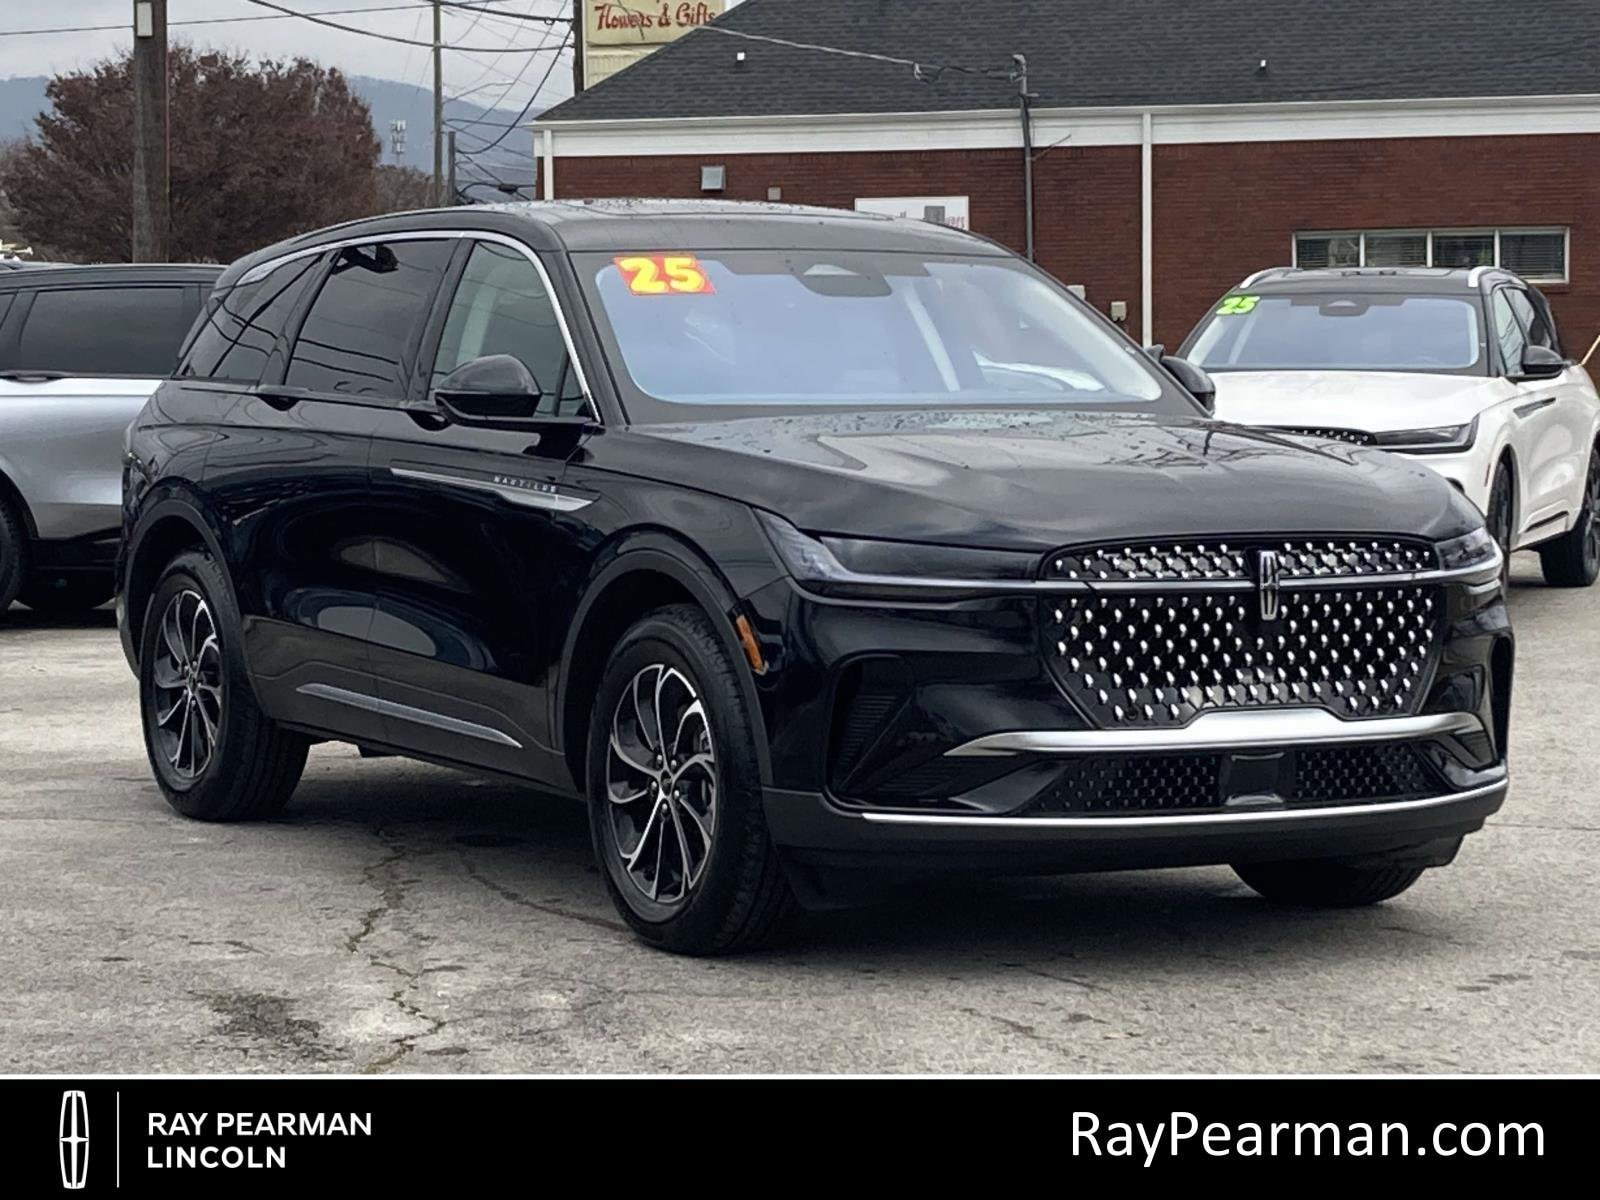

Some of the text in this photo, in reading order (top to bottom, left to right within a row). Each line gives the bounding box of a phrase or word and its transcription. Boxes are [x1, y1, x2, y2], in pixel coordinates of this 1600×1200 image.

[594, 1, 716, 31] Flowers & Gifts
[619, 256, 706, 293] 25
[1215, 295, 1261, 315] 25
[494, 475, 557, 493] NAUTILUS
